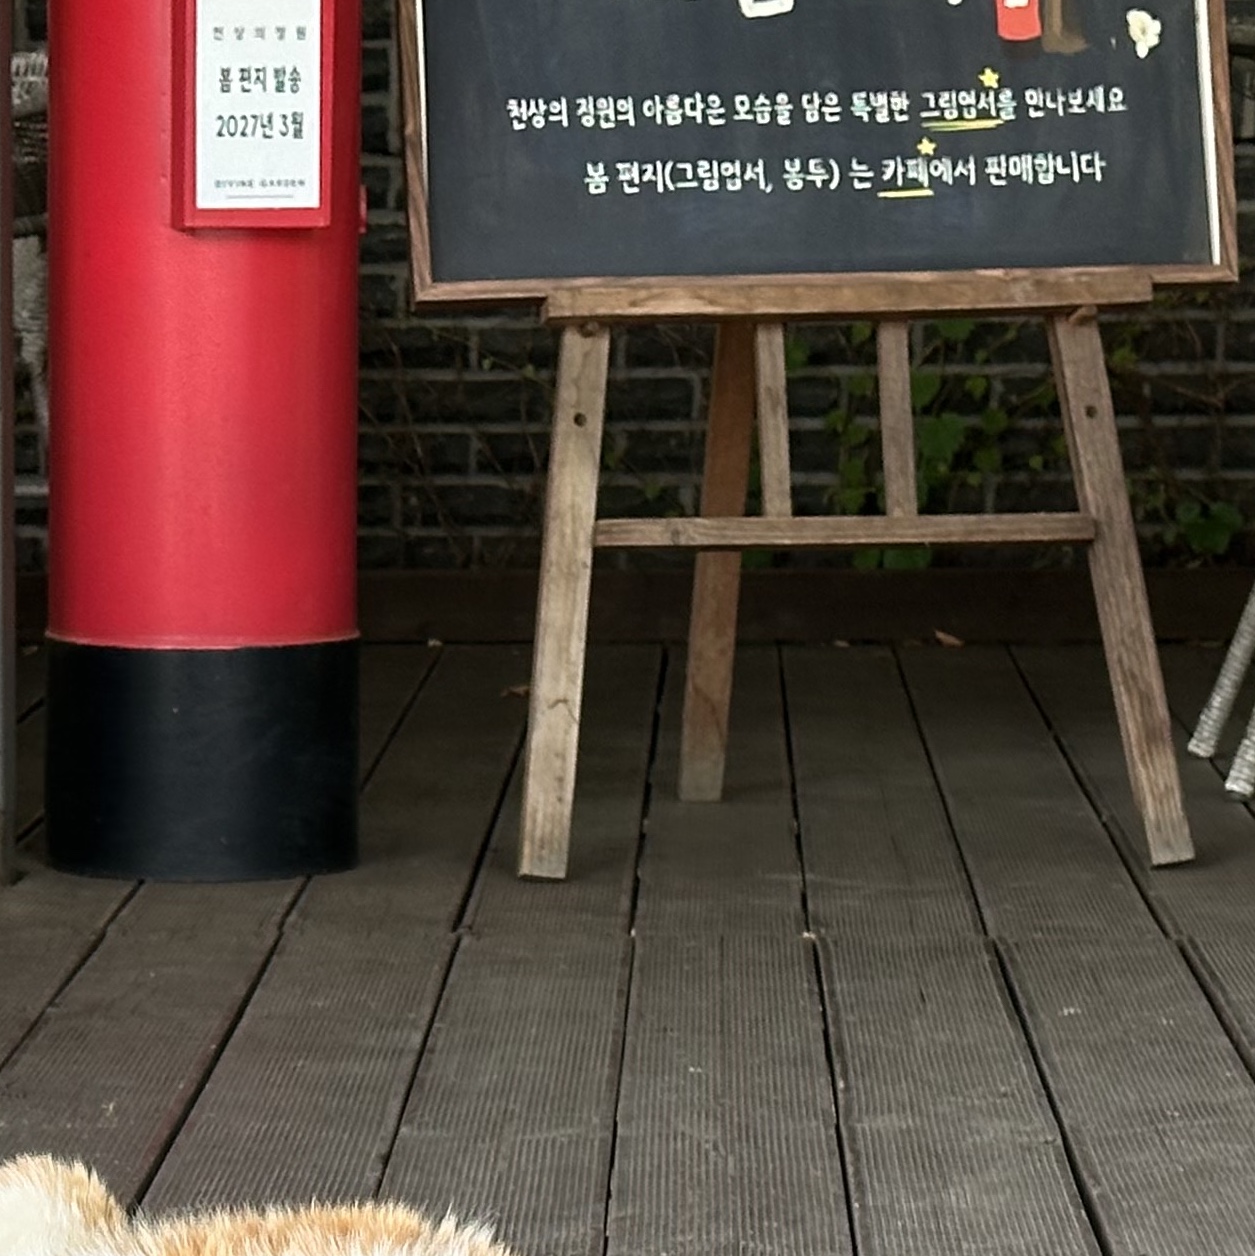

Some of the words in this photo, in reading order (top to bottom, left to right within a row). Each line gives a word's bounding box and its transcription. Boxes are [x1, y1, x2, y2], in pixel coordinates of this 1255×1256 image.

[219, 67, 233, 94] 봄
[238, 66, 267, 94] 편지
[273, 66, 302, 94] 발송
[215, 112, 274, 140] 2027년
[279, 111, 304, 140] 3월
[506, 95, 569, 131] 천상의
[575, 94, 636, 130] 정원의
[642, 91, 726, 127] 아름다운
[732, 92, 794, 126] 모습을
[801, 90, 843, 124] 담은
[850, 90, 910, 124] 특별한
[583, 160, 610, 195] 봄
[881, 154, 976, 188] 카페에서
[984, 151, 1107, 187] 판매합니다
